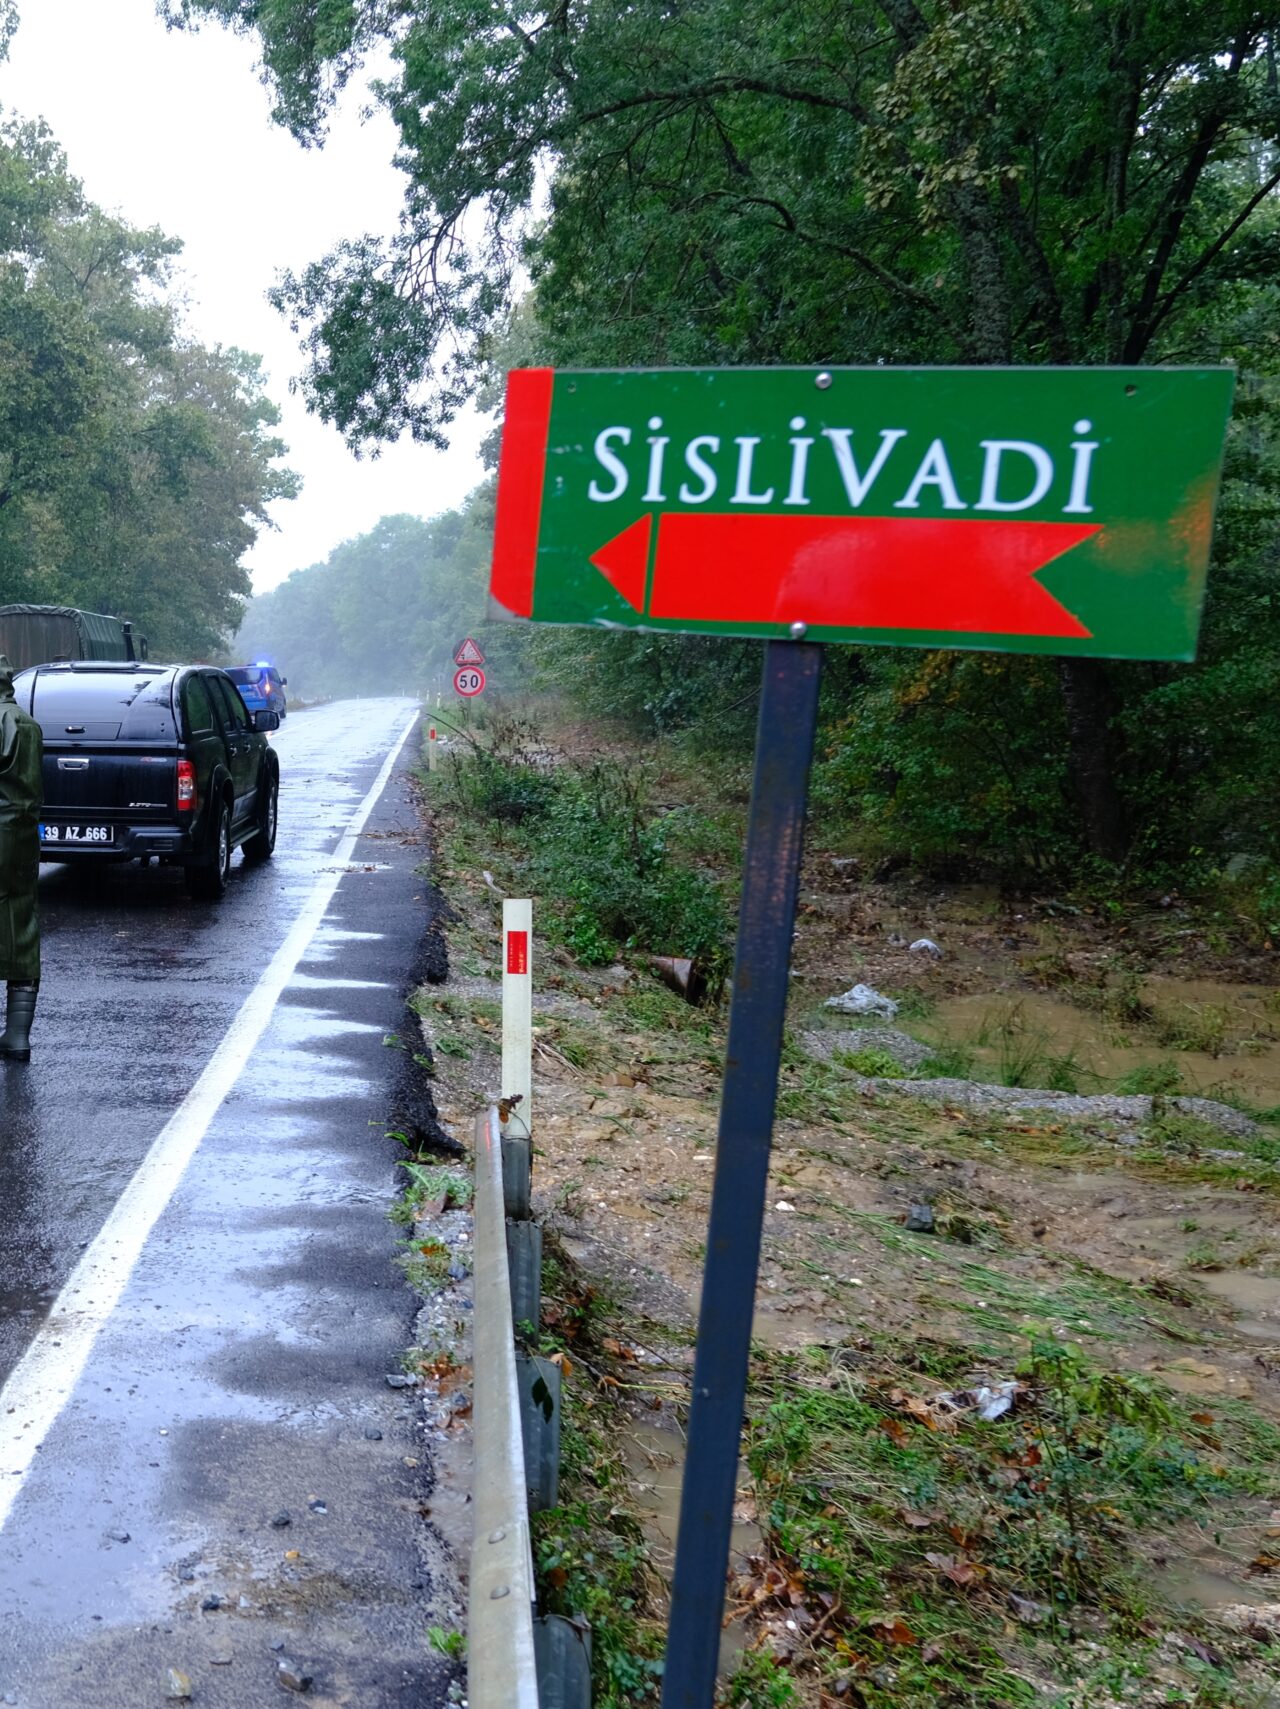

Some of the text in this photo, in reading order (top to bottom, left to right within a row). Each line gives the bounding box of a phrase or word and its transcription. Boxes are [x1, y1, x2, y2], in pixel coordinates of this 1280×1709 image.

[460, 674, 479, 689] 50
[44, 826, 107, 840] 39 AZ 666
